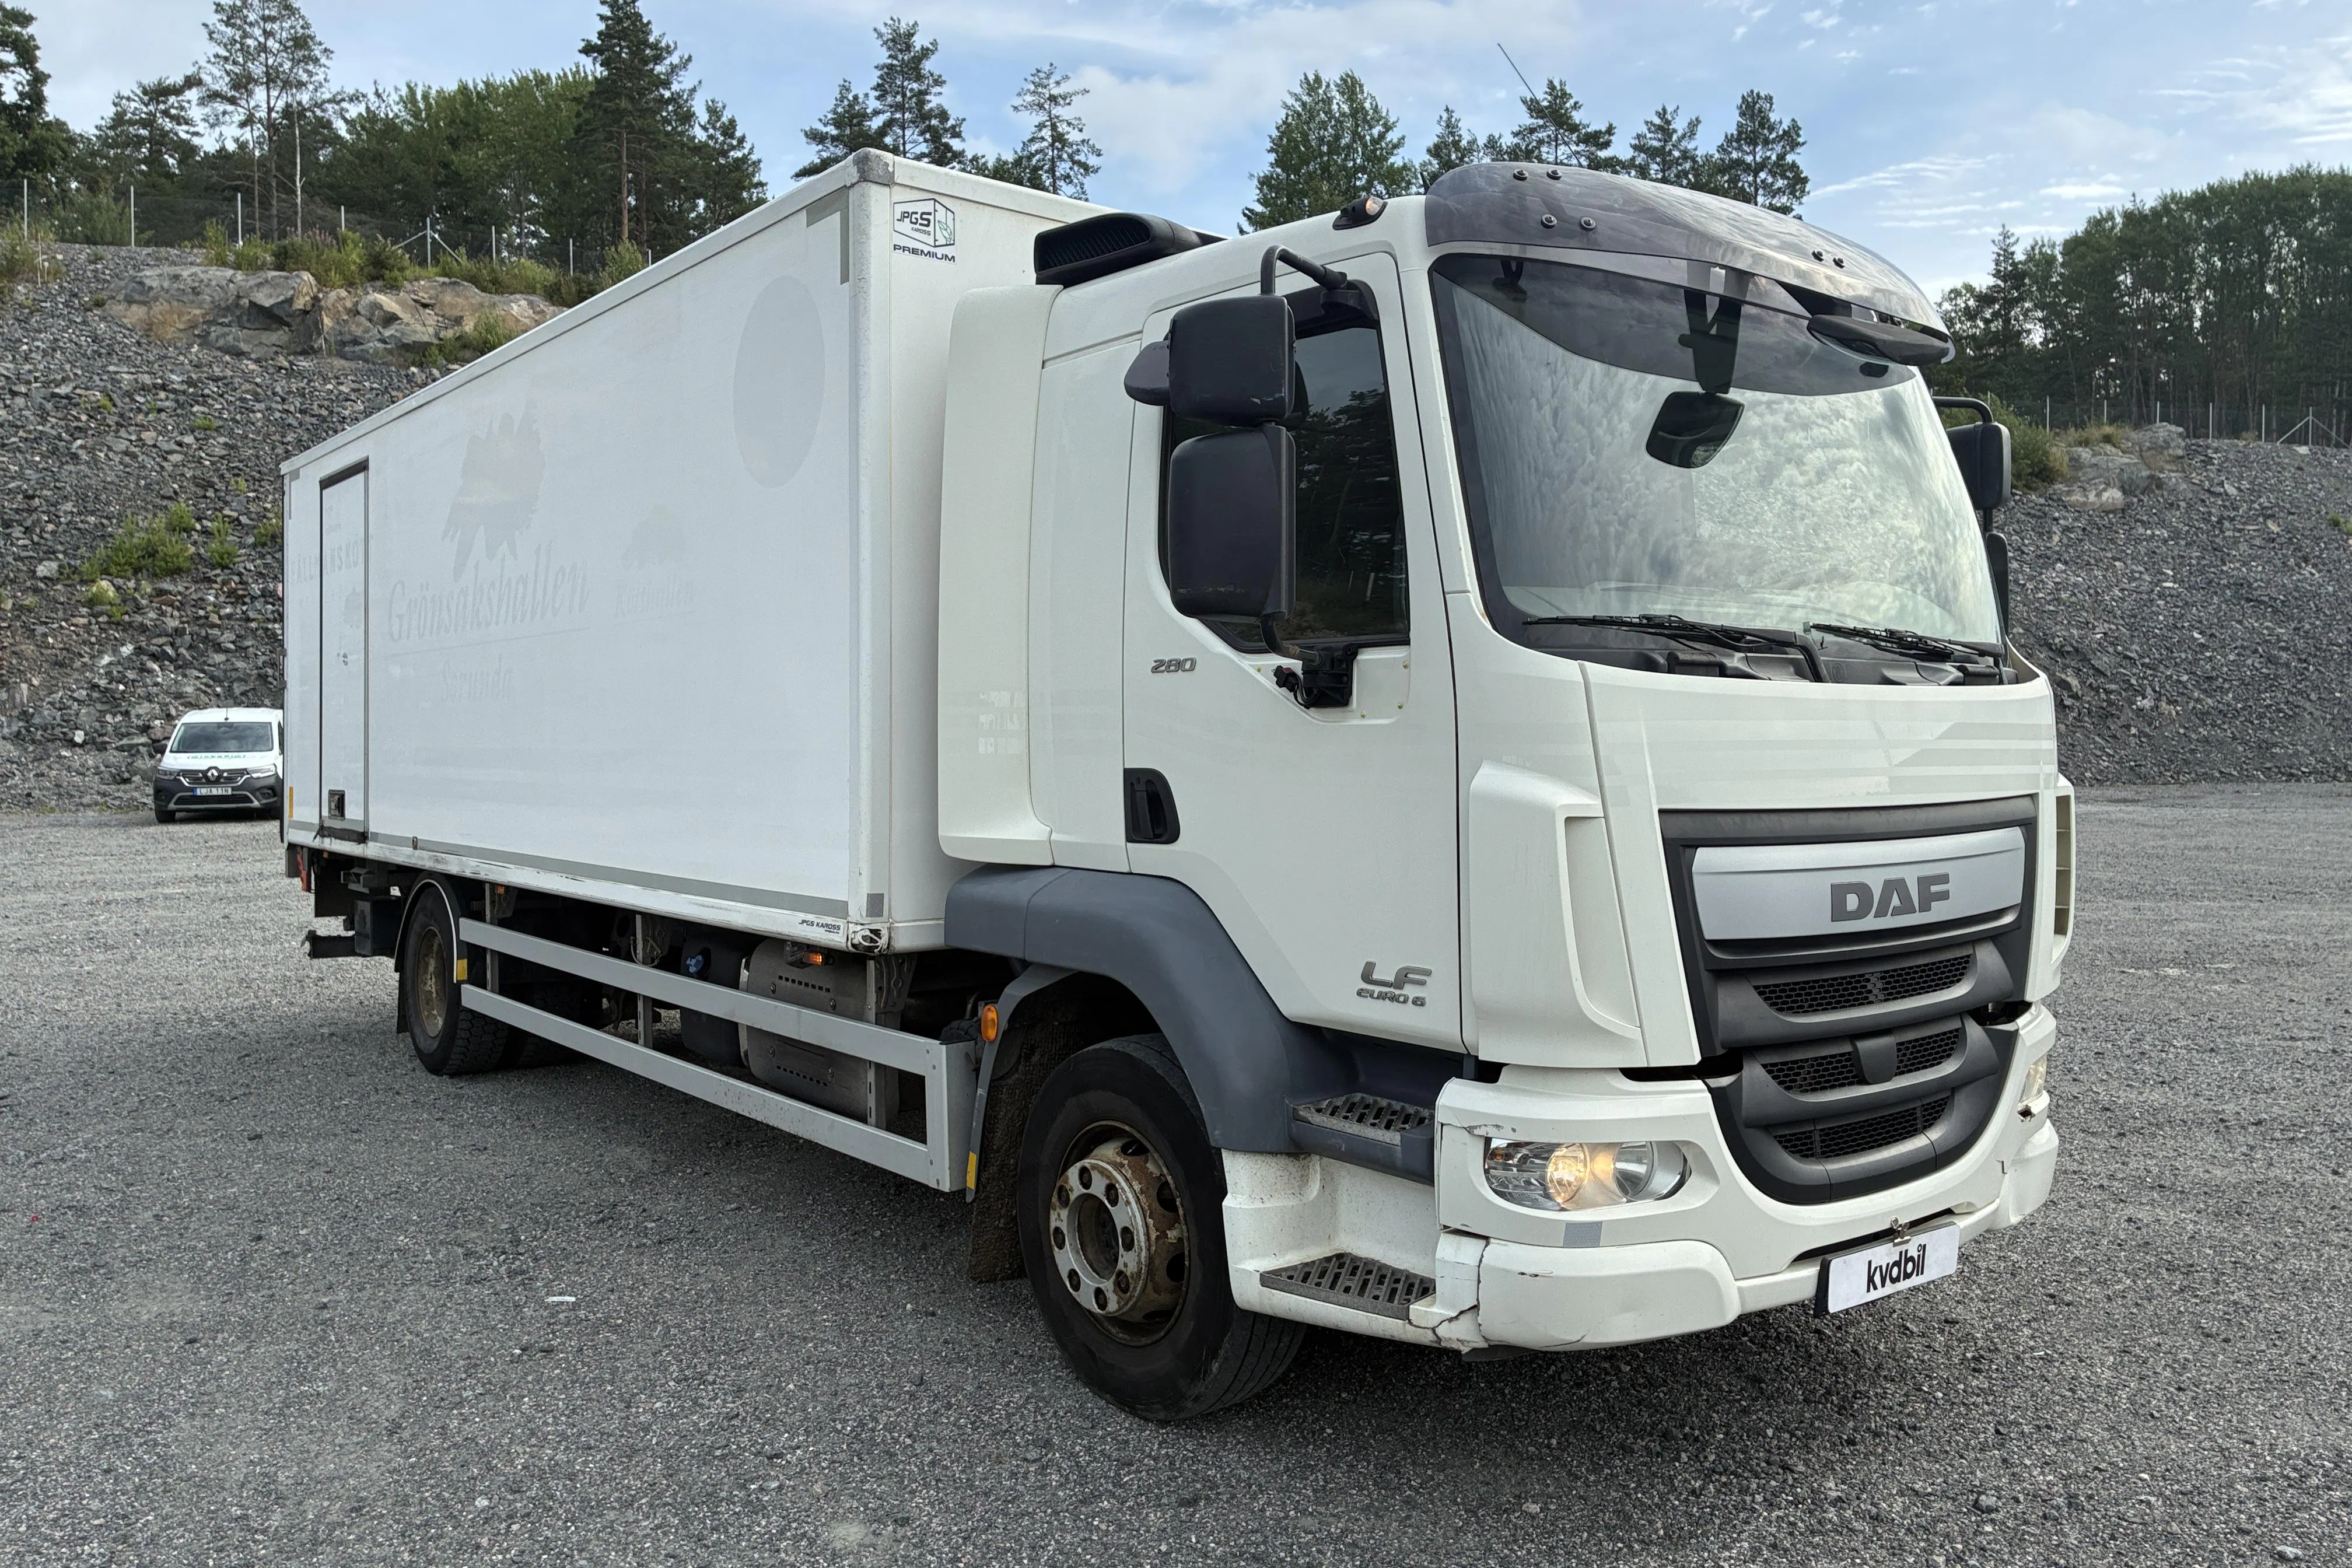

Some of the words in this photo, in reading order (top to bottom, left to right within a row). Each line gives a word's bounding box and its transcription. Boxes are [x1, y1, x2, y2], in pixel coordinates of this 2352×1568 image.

[896, 211, 932, 228] JPGS
[911, 226, 932, 236] KAROSS
[893, 244, 956, 262] PREMIUM
[388, 537, 590, 643] Grönsakshallen
[1151, 657, 1197, 673] 280
[1831, 872, 1950, 922] DAF
[799, 919, 815, 927] JPGS
[816, 922, 841, 931] KAROSS
[1361, 961, 1432, 990] LF
[1356, 987, 1409, 1004] EURO
[1412, 996, 1426, 1007] 6
[1867, 1243, 1927, 1293] kvdbil
